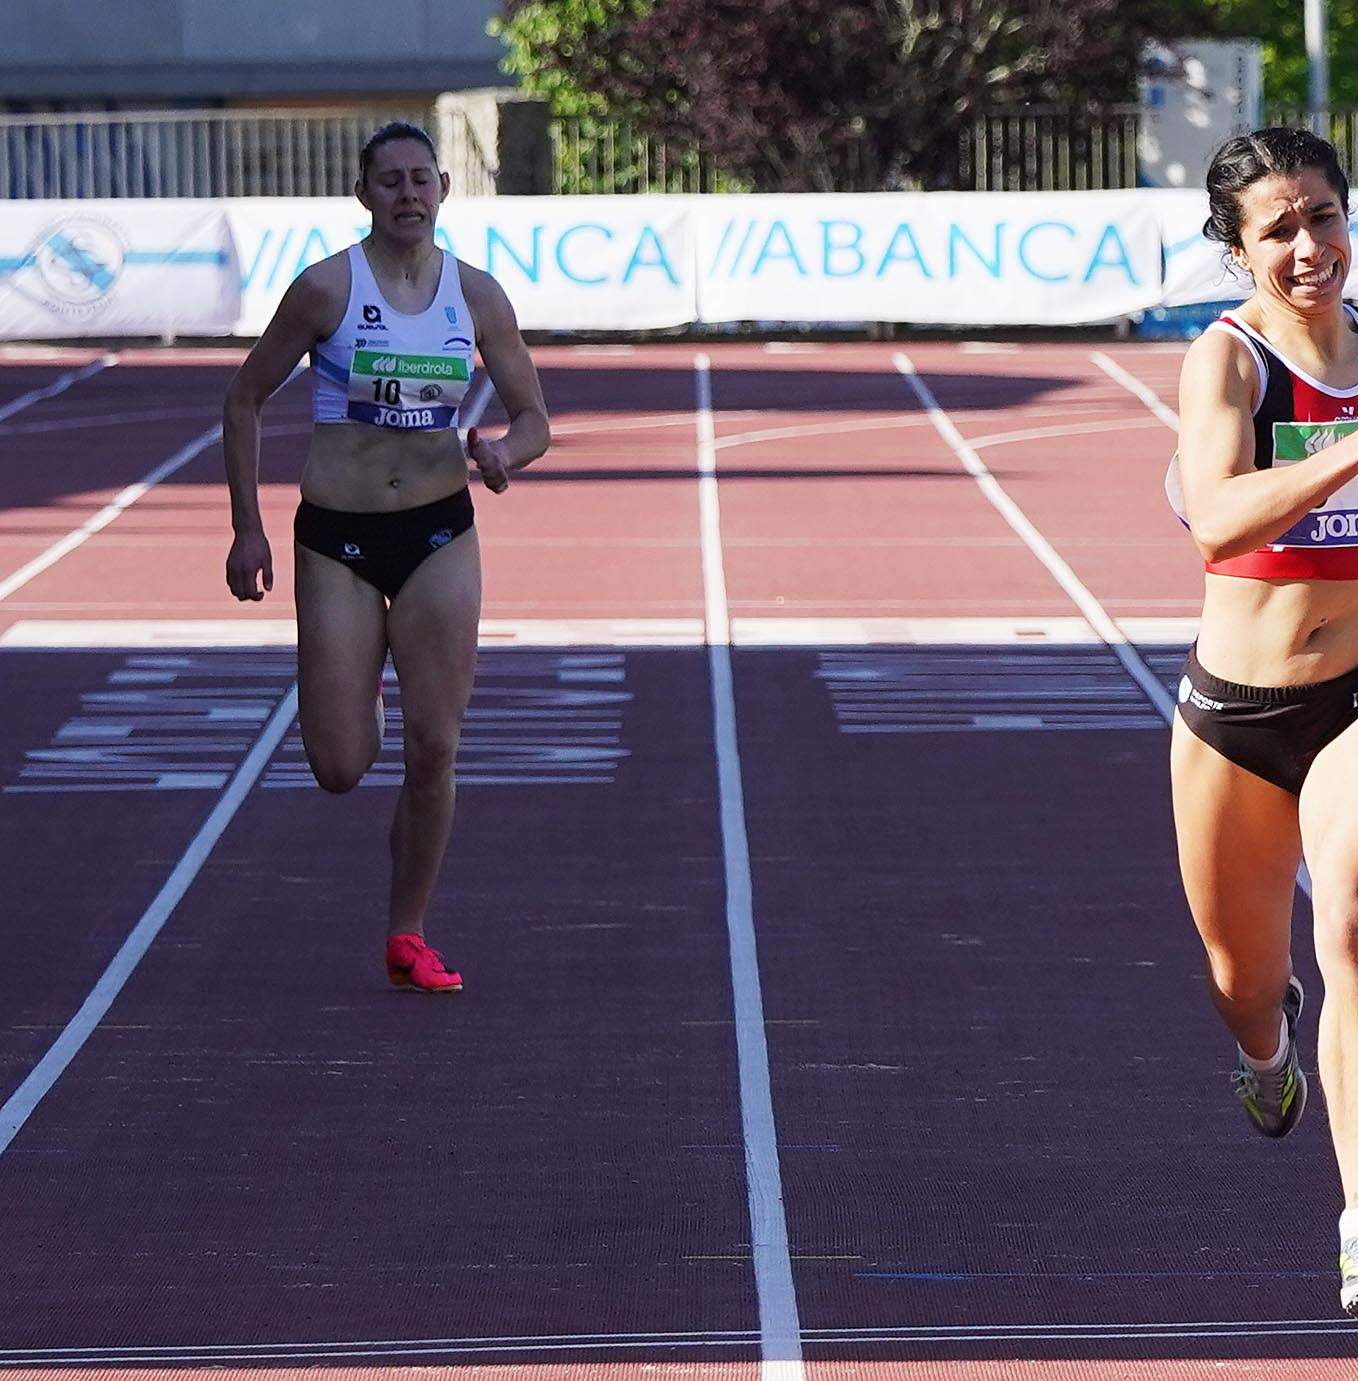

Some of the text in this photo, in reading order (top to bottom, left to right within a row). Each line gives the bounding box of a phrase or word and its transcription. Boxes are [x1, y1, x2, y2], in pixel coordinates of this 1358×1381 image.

[398, 358, 453, 375] Iberdrola
[372, 378, 401, 405] 10
[374, 406, 435, 428] Joma
